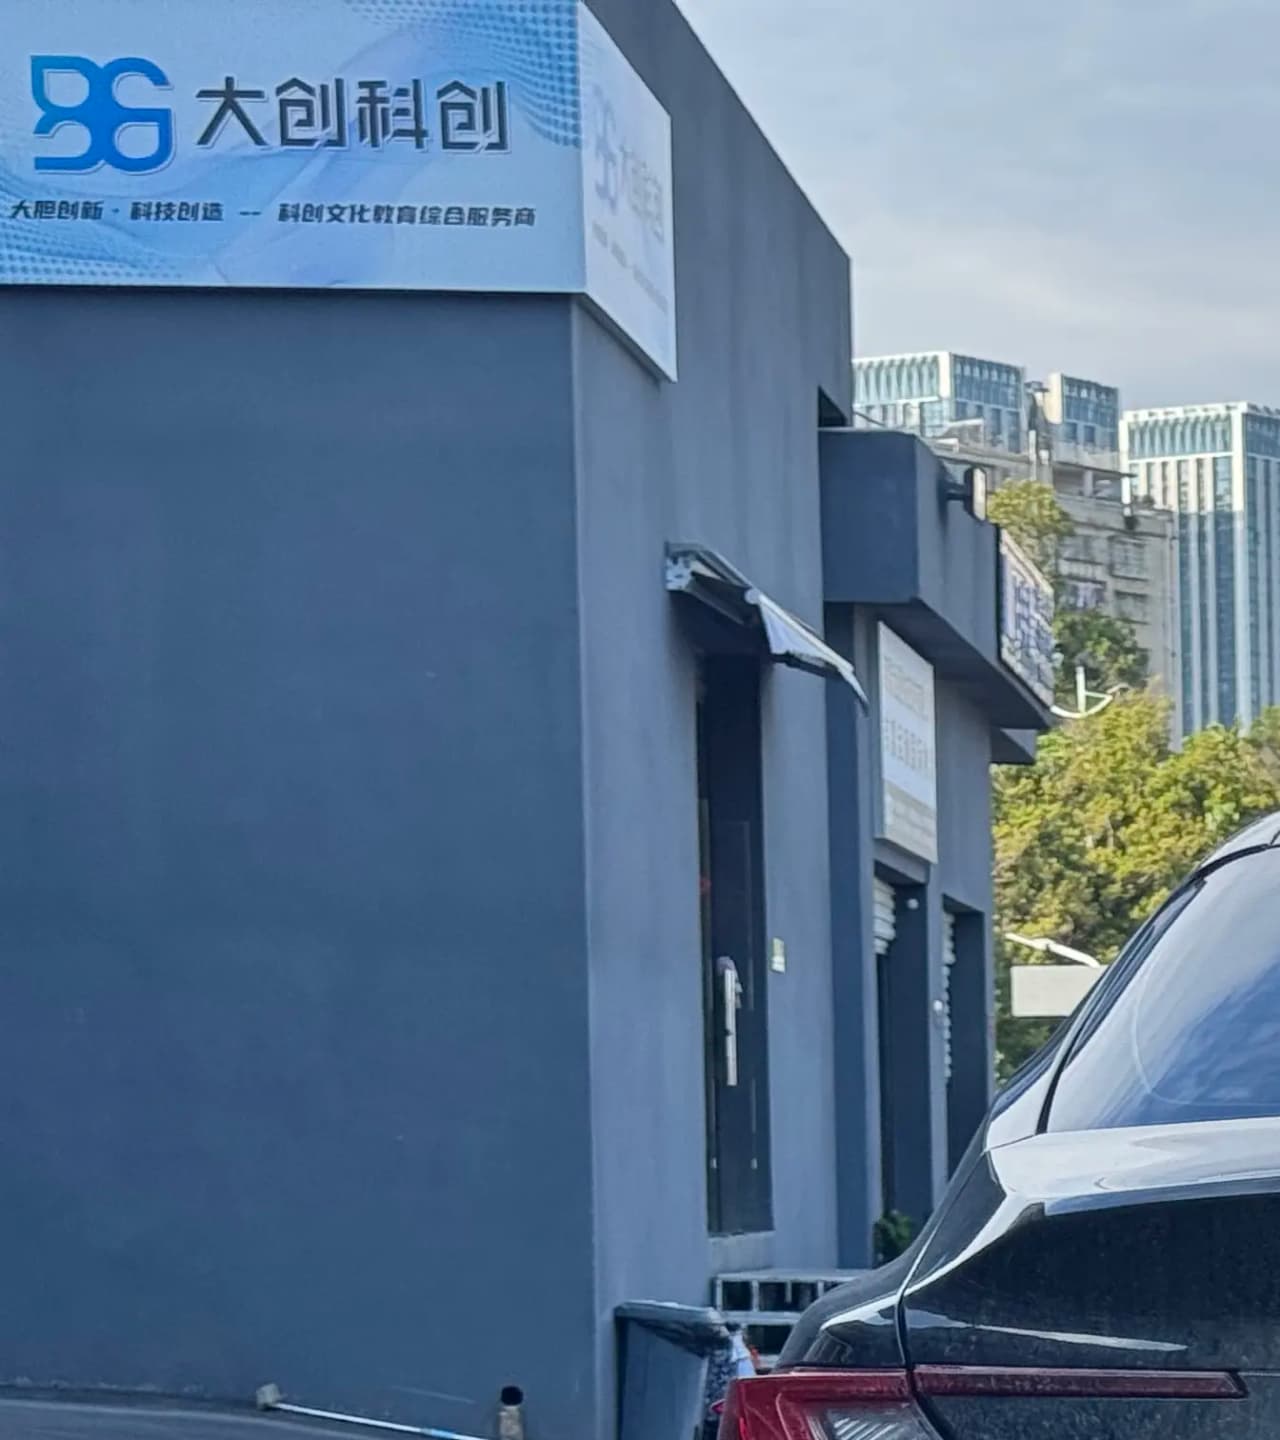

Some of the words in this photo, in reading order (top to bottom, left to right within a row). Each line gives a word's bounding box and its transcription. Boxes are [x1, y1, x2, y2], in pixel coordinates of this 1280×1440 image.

[195, 76, 509, 151] 大创科创
[11, 200, 104, 221] 大胆创新
[130, 201, 224, 222] 科技创造
[278, 203, 536, 227] 科创文化教育综合服务商
